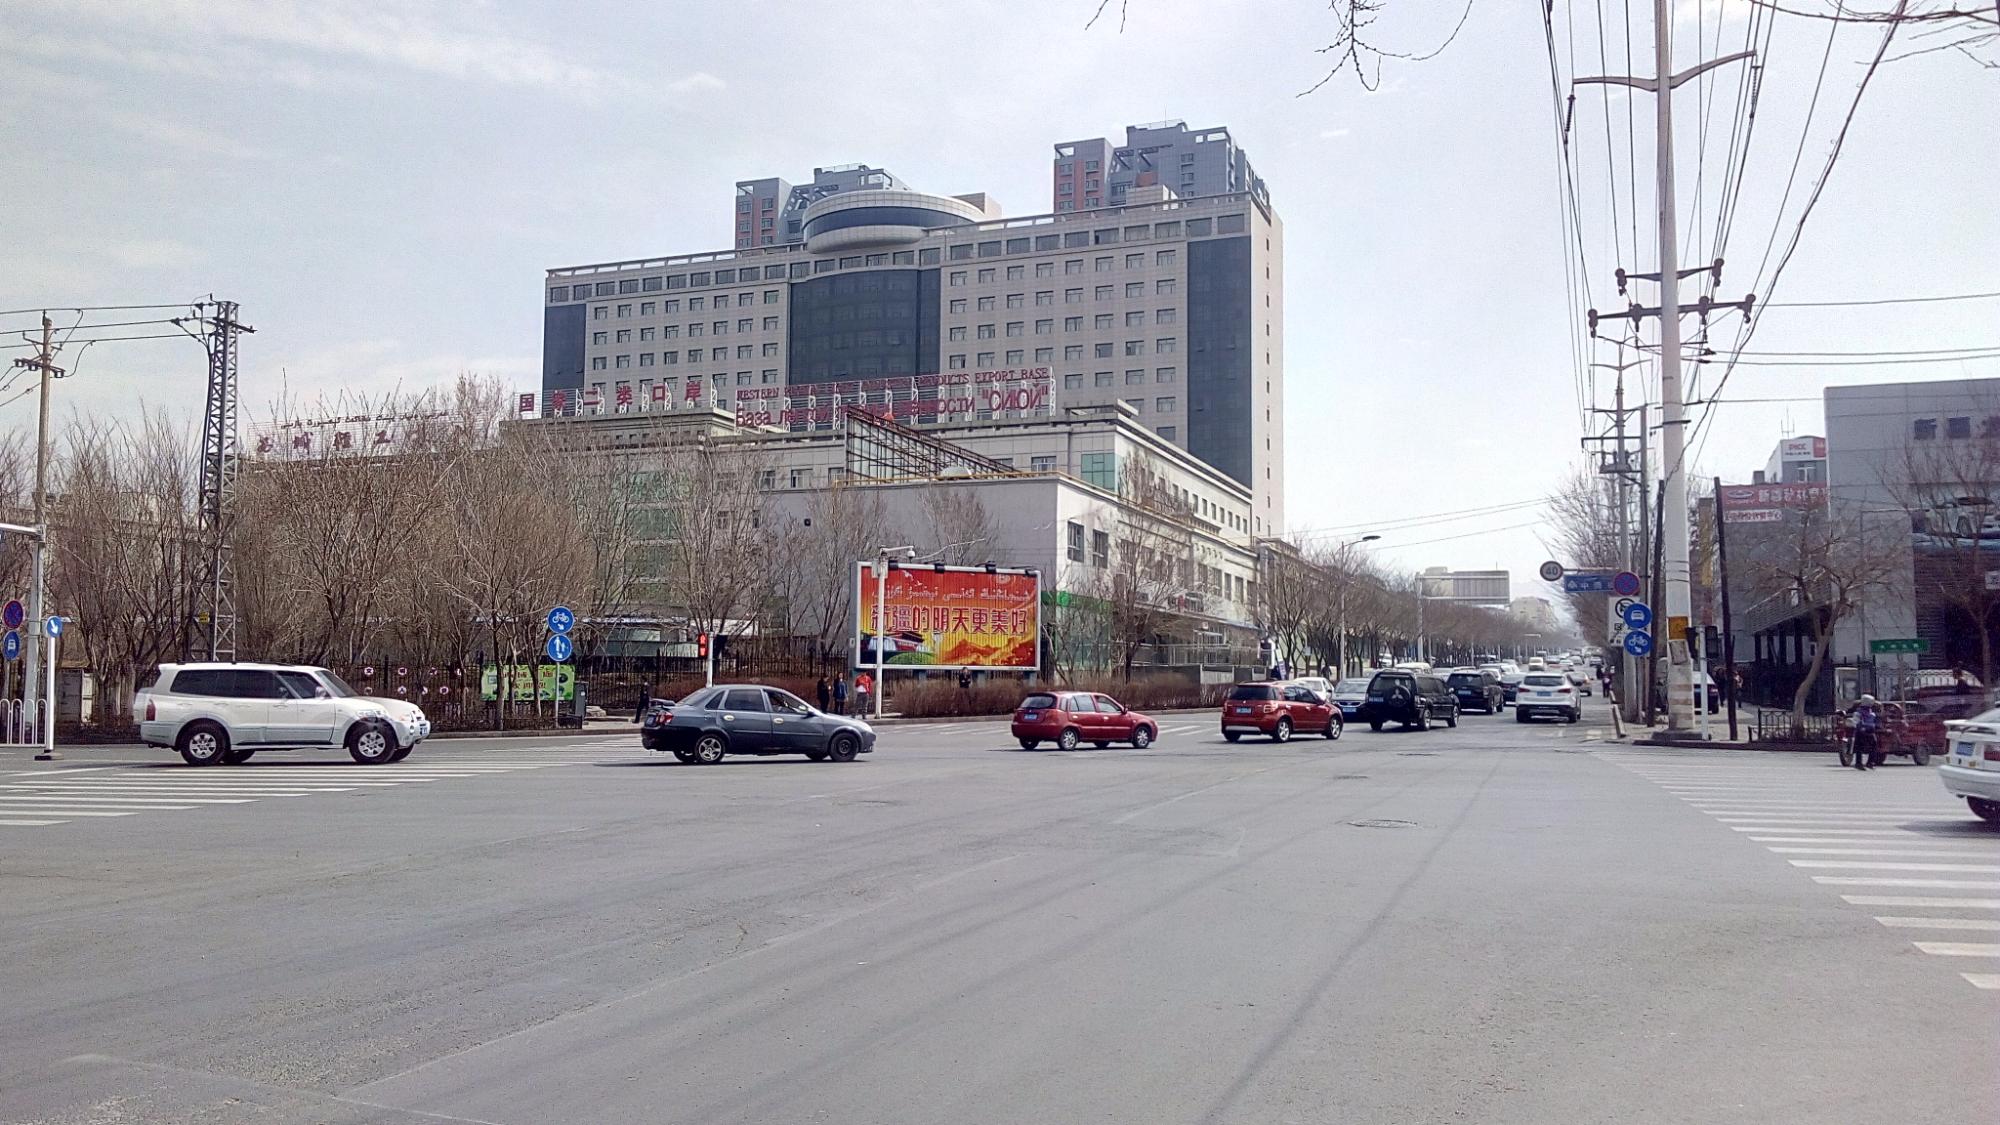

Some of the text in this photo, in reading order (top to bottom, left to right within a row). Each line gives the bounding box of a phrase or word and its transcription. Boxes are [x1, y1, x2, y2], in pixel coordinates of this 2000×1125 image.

[737, 388, 780, 400] WESTERN
[975, 370, 1015, 383] EXPORT
[1021, 367, 1049, 379] BASE
[736, 407, 772, 427] База
[1546, 566, 1558, 576] 40
[872, 604, 1027, 635] 新疆的明天更美好
